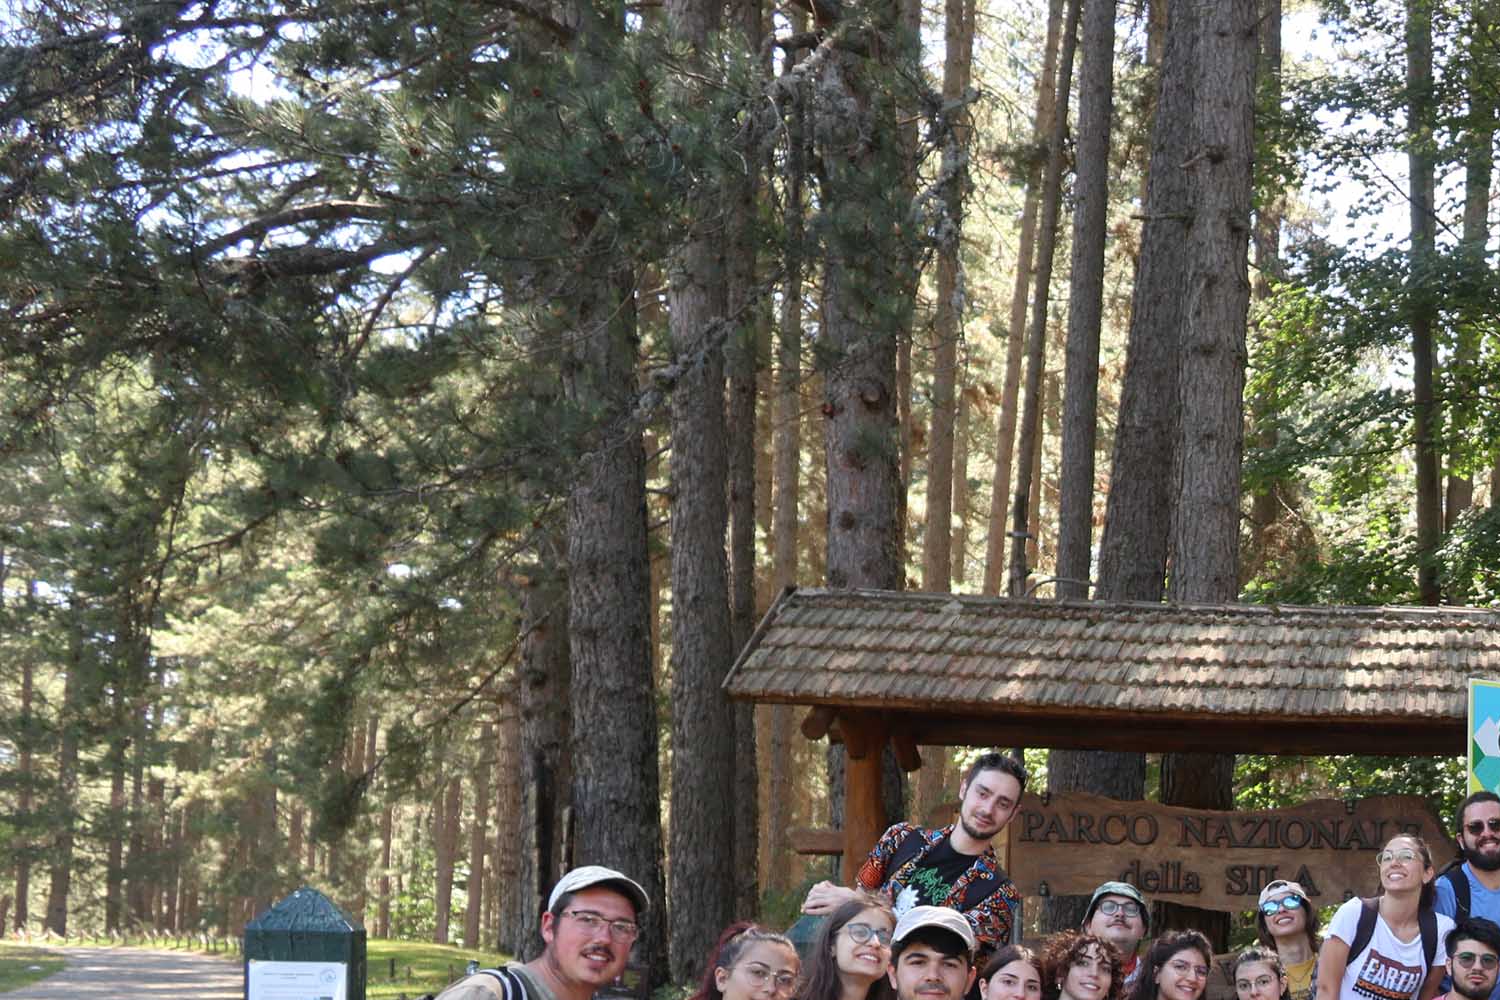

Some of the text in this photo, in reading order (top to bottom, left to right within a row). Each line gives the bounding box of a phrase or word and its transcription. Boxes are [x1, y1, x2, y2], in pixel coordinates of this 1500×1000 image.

[1019, 810, 1159, 845] PARCO
[1119, 860, 1201, 894] della
[1361, 958, 1420, 992] EARTH
